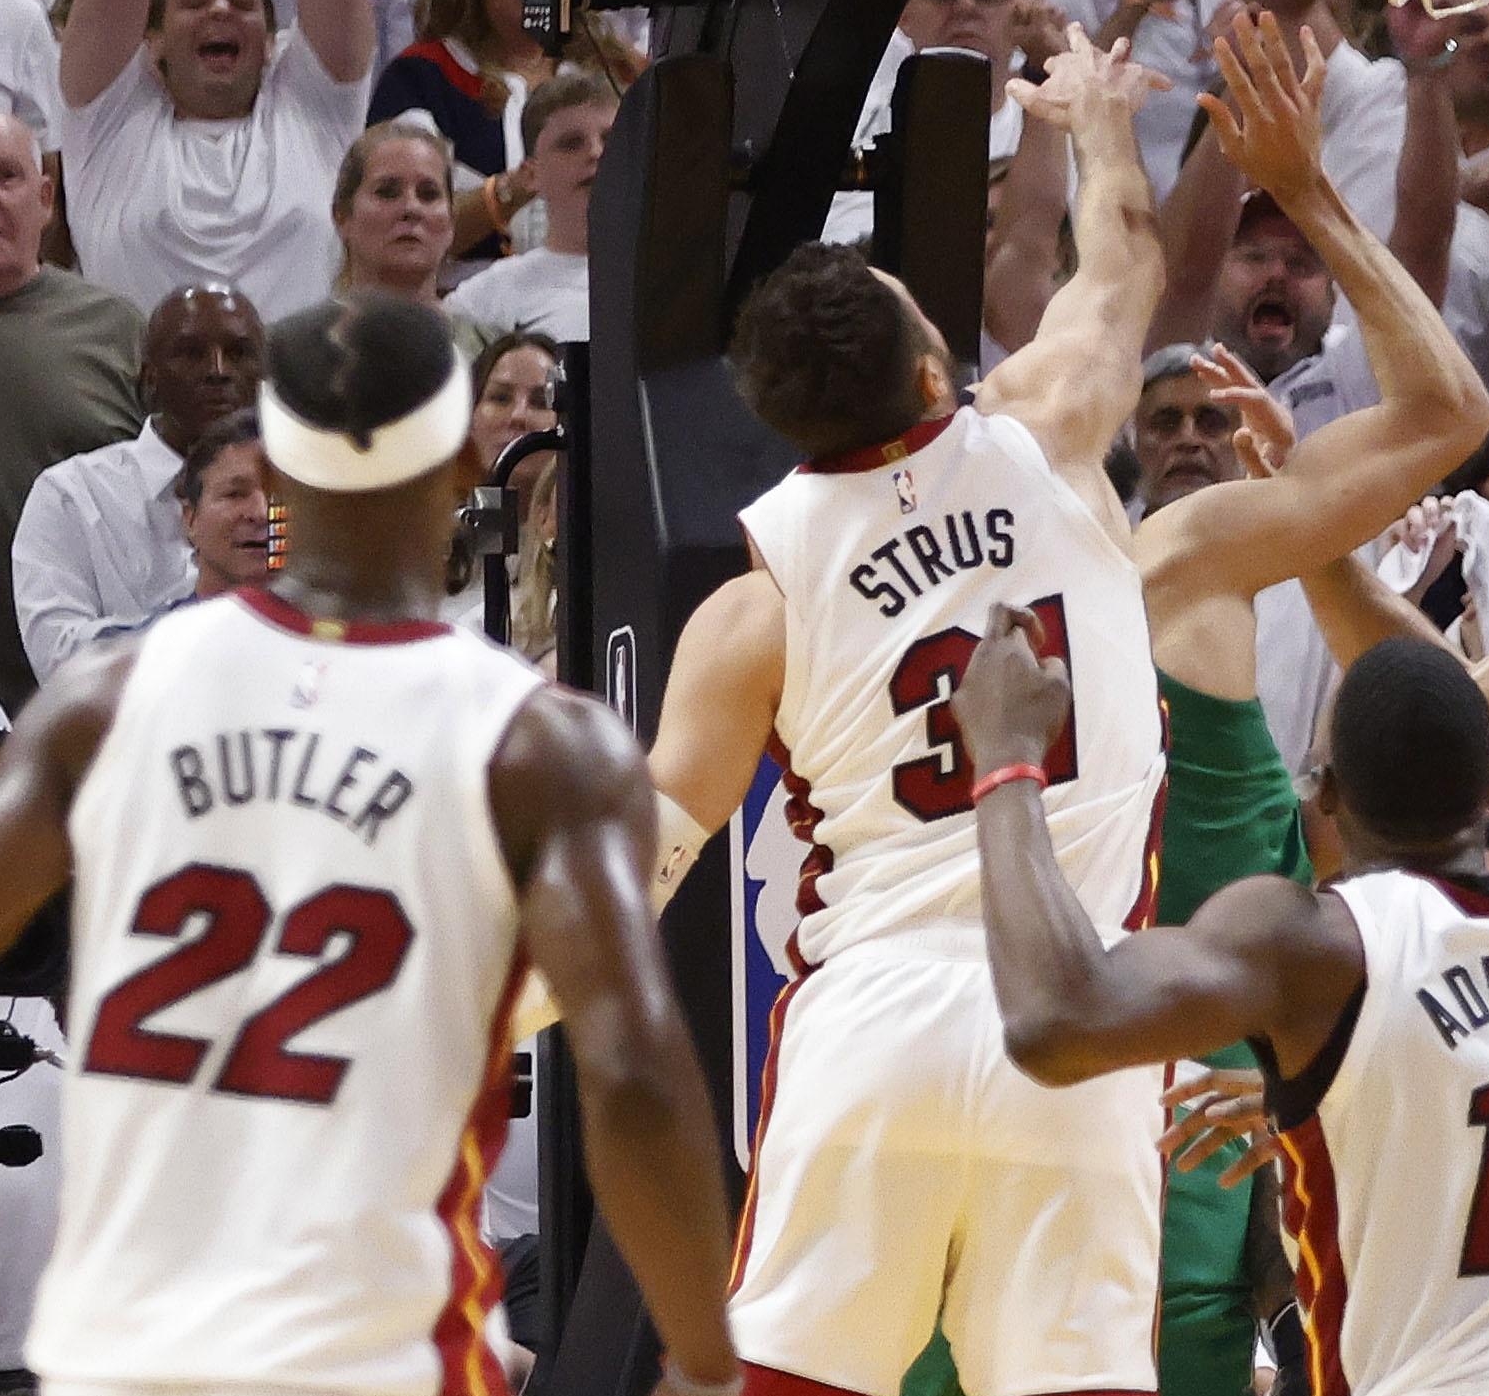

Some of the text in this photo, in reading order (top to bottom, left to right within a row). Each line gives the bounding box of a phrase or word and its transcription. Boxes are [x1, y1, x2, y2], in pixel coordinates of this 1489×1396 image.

[848, 508, 1016, 617] STRUS
[169, 731, 415, 850] BUTLER
[889, 591, 1078, 823] 31
[84, 861, 415, 1106] 22
